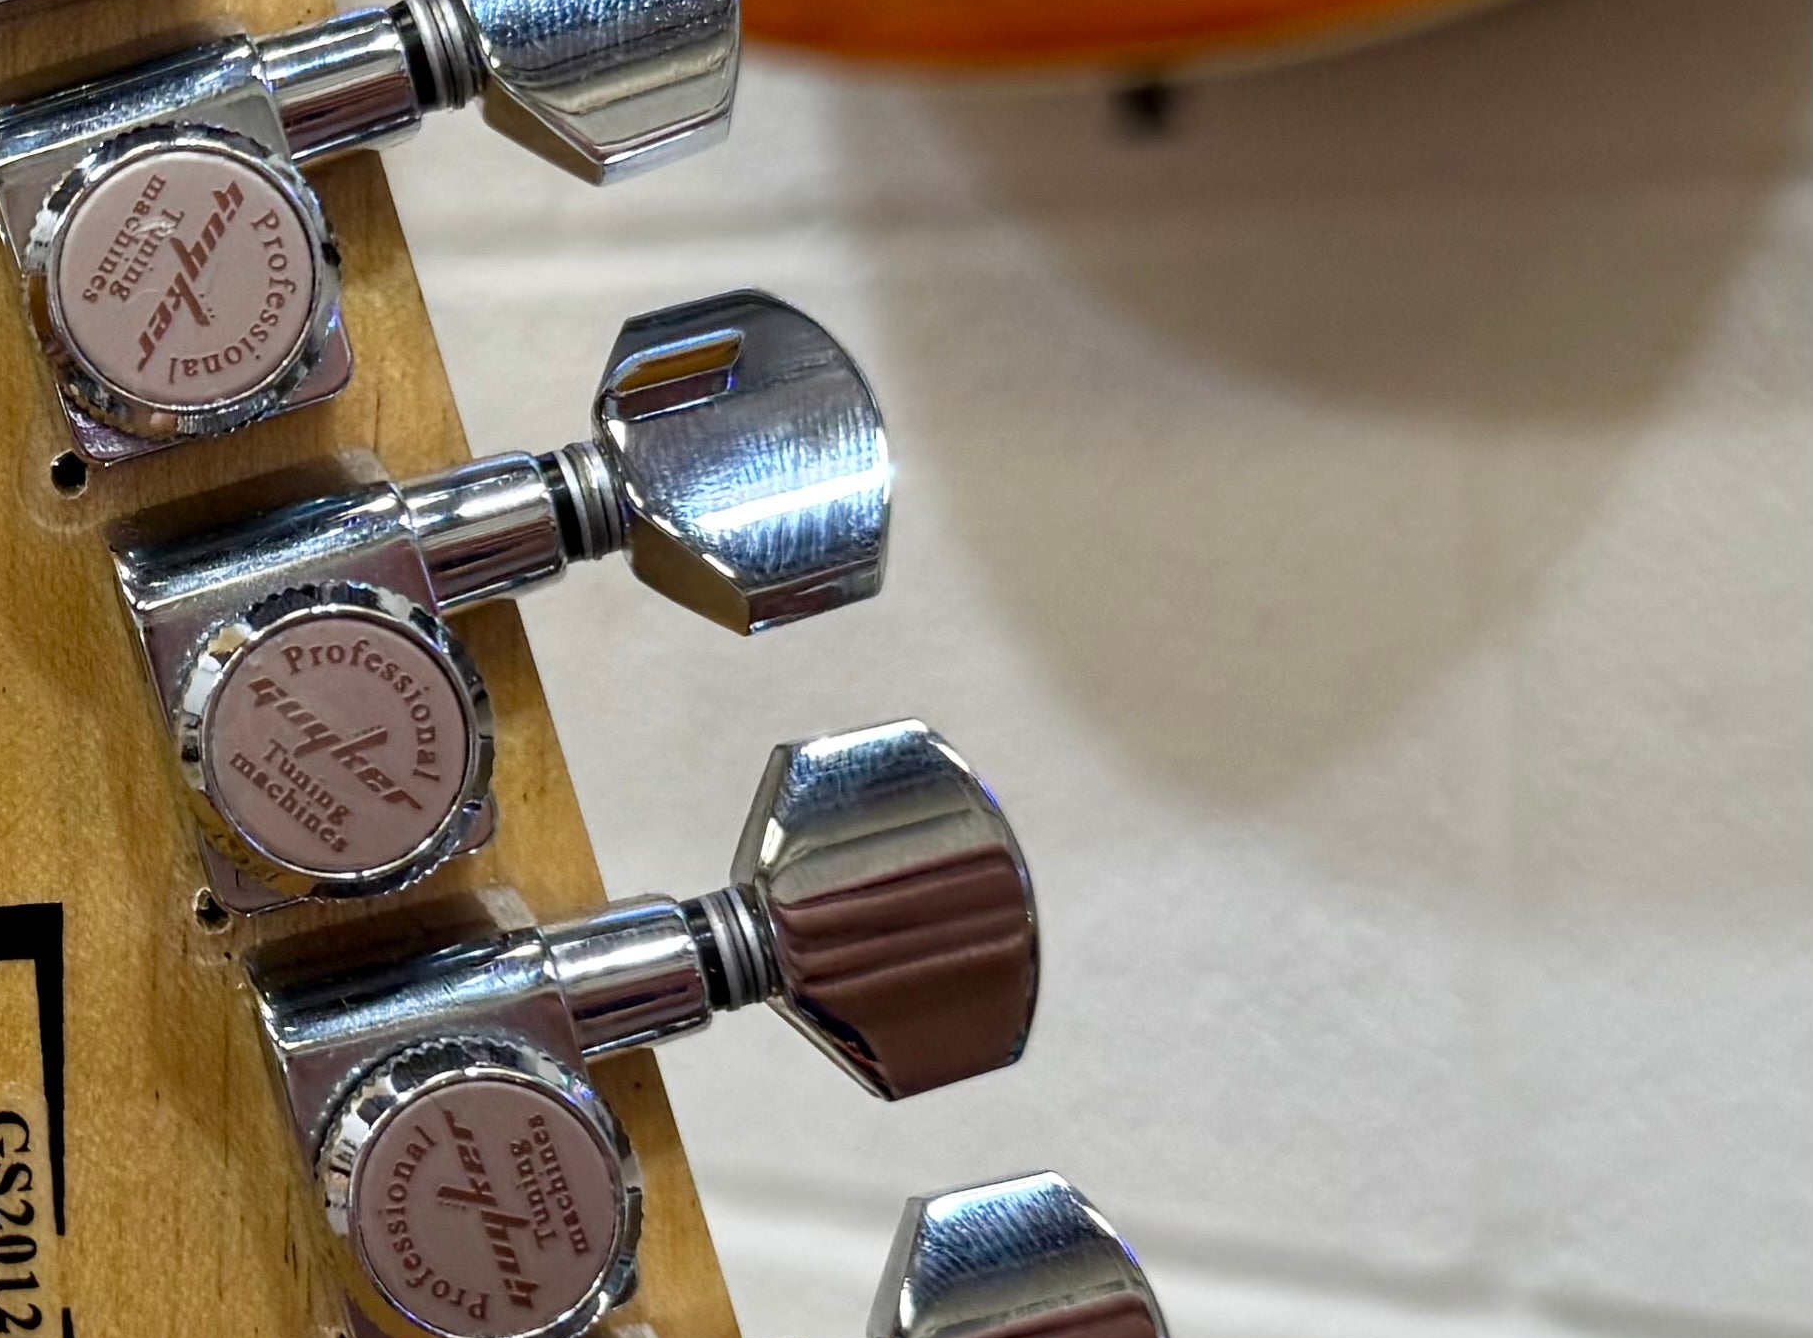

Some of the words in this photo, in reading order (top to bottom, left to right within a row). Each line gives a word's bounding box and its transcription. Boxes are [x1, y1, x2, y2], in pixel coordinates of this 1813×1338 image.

[82, 174, 167, 304] machines
[168, 209, 297, 385] Professional
[282, 639, 440, 782] Professional
[230, 753, 349, 853] machines
[262, 739, 352, 826] Tuning
[379, 1125, 490, 1320] Professional
[510, 1138, 553, 1248] Tuning
[529, 1113, 590, 1257] machines
